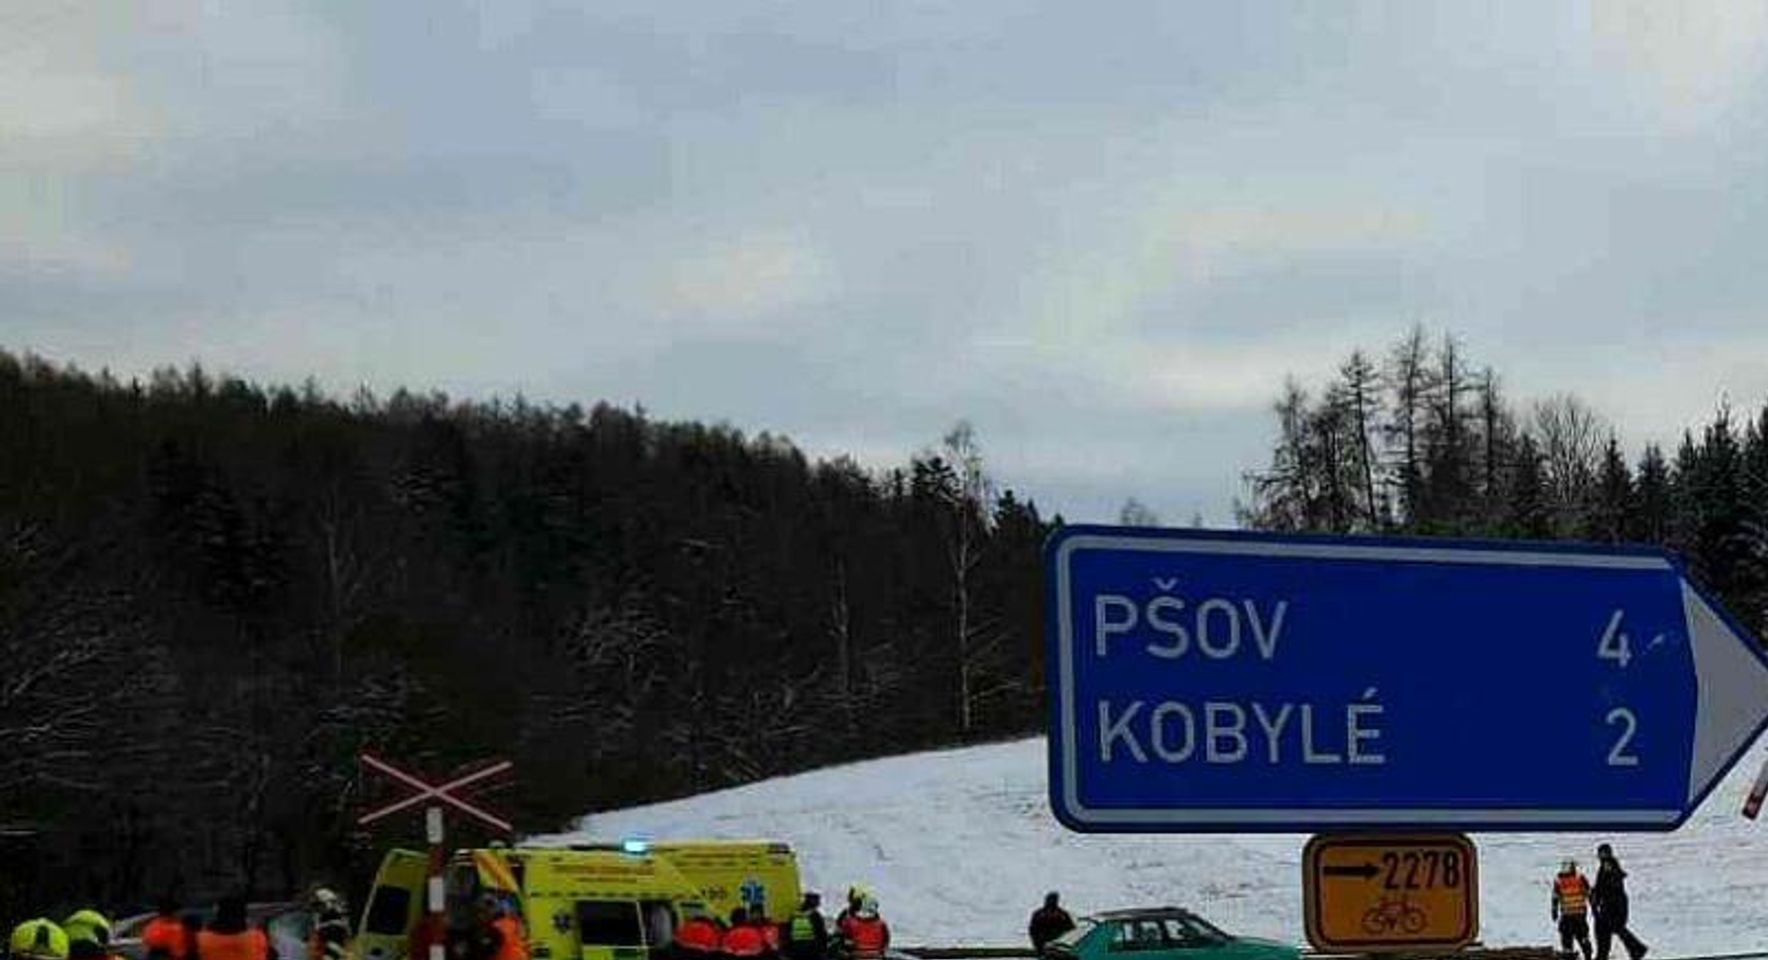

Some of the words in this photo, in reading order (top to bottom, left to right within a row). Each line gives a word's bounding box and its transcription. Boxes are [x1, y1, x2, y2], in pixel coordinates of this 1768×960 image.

[1095, 576, 1288, 660] PŠOV
[1598, 609, 1632, 668] 4
[1098, 686, 1385, 764] KOBYLÉ
[1606, 707, 1639, 766] 2
[1383, 850, 1459, 890] 2278
